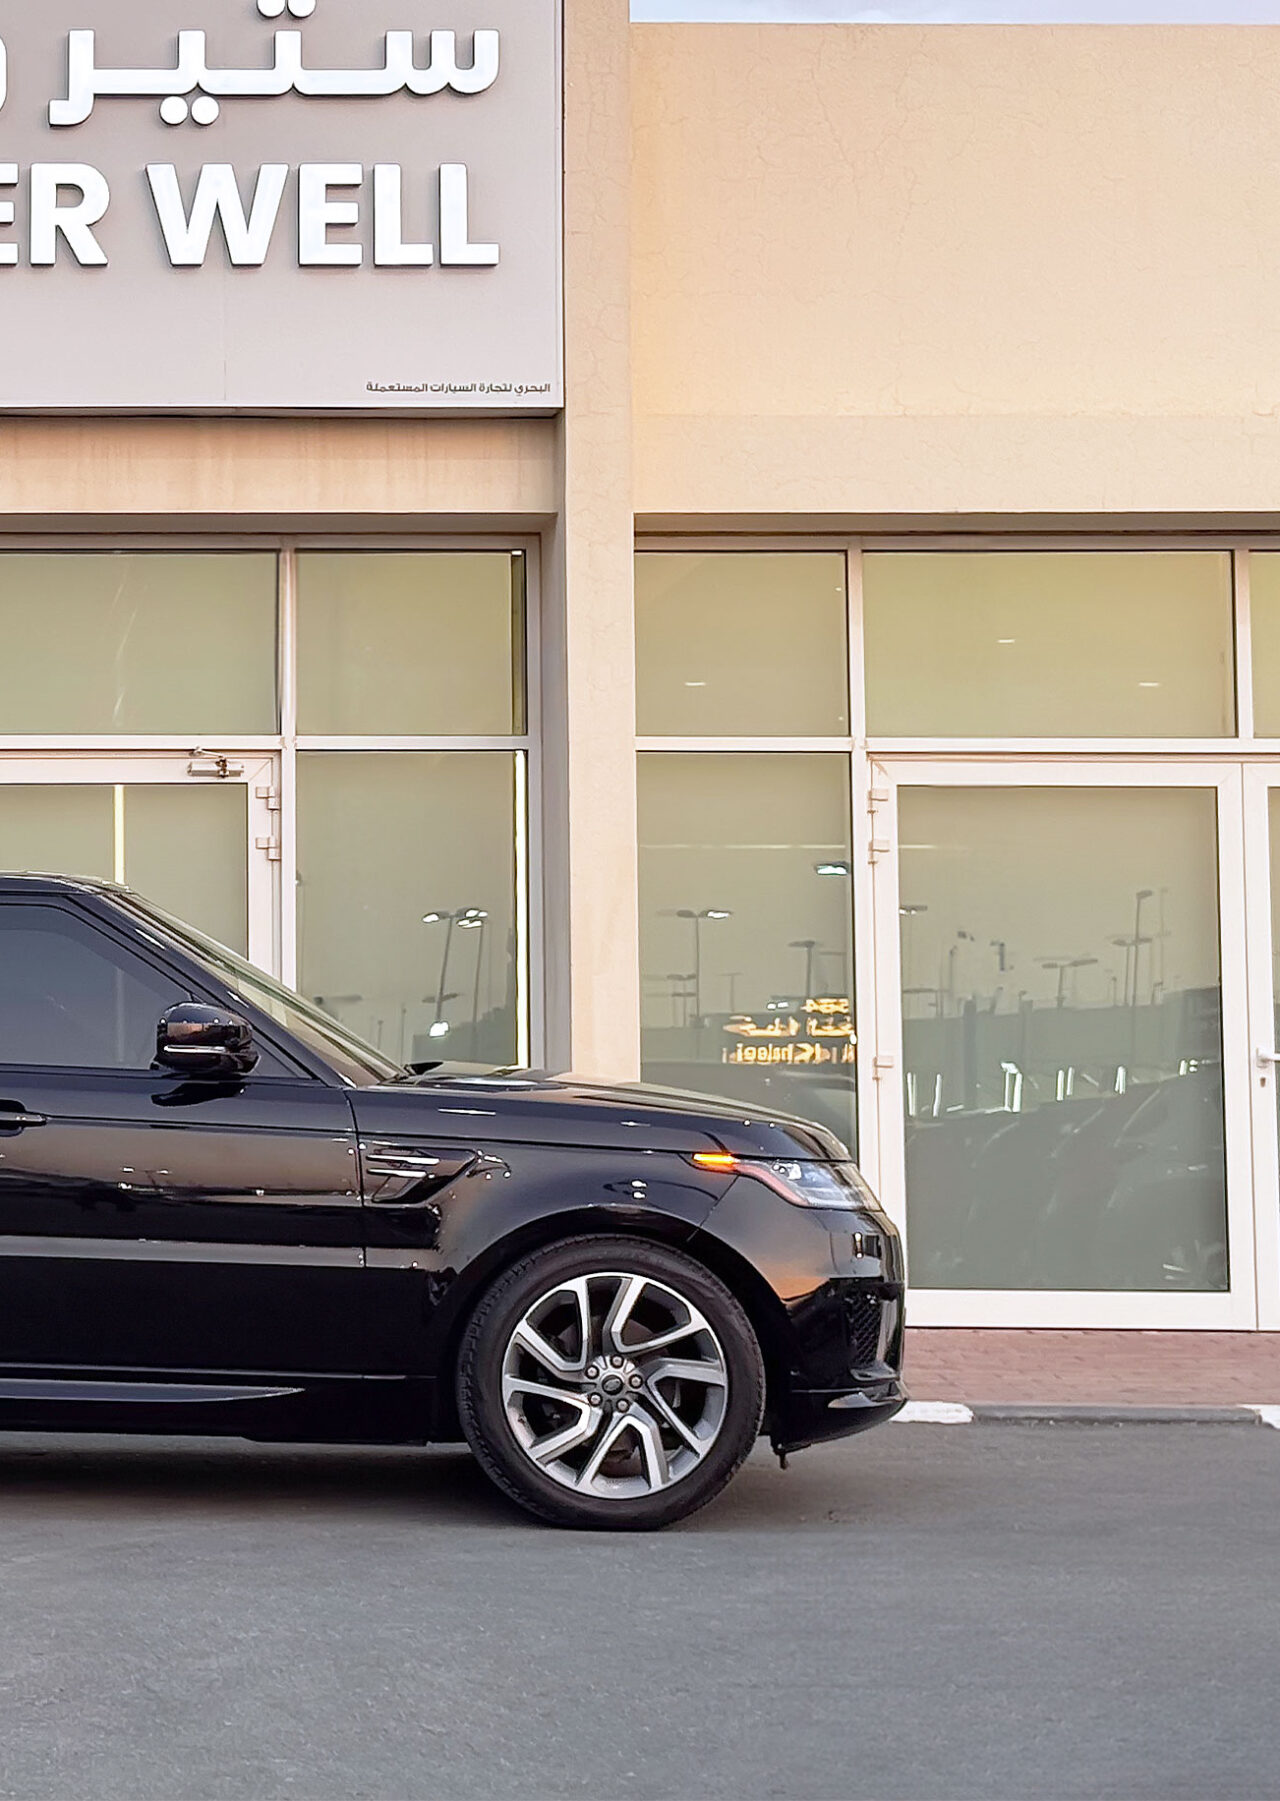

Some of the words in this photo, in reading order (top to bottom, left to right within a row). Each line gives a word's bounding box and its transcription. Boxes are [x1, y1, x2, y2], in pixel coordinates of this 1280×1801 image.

[49, 0, 500, 127] ستير
[146, 162, 500, 267] WELL
[366, 381, 428, 393] المستعملة
[429, 382, 477, 393] السيارات
[478, 382, 513, 393] لتجارة
[513, 382, 551, 397] البحري
